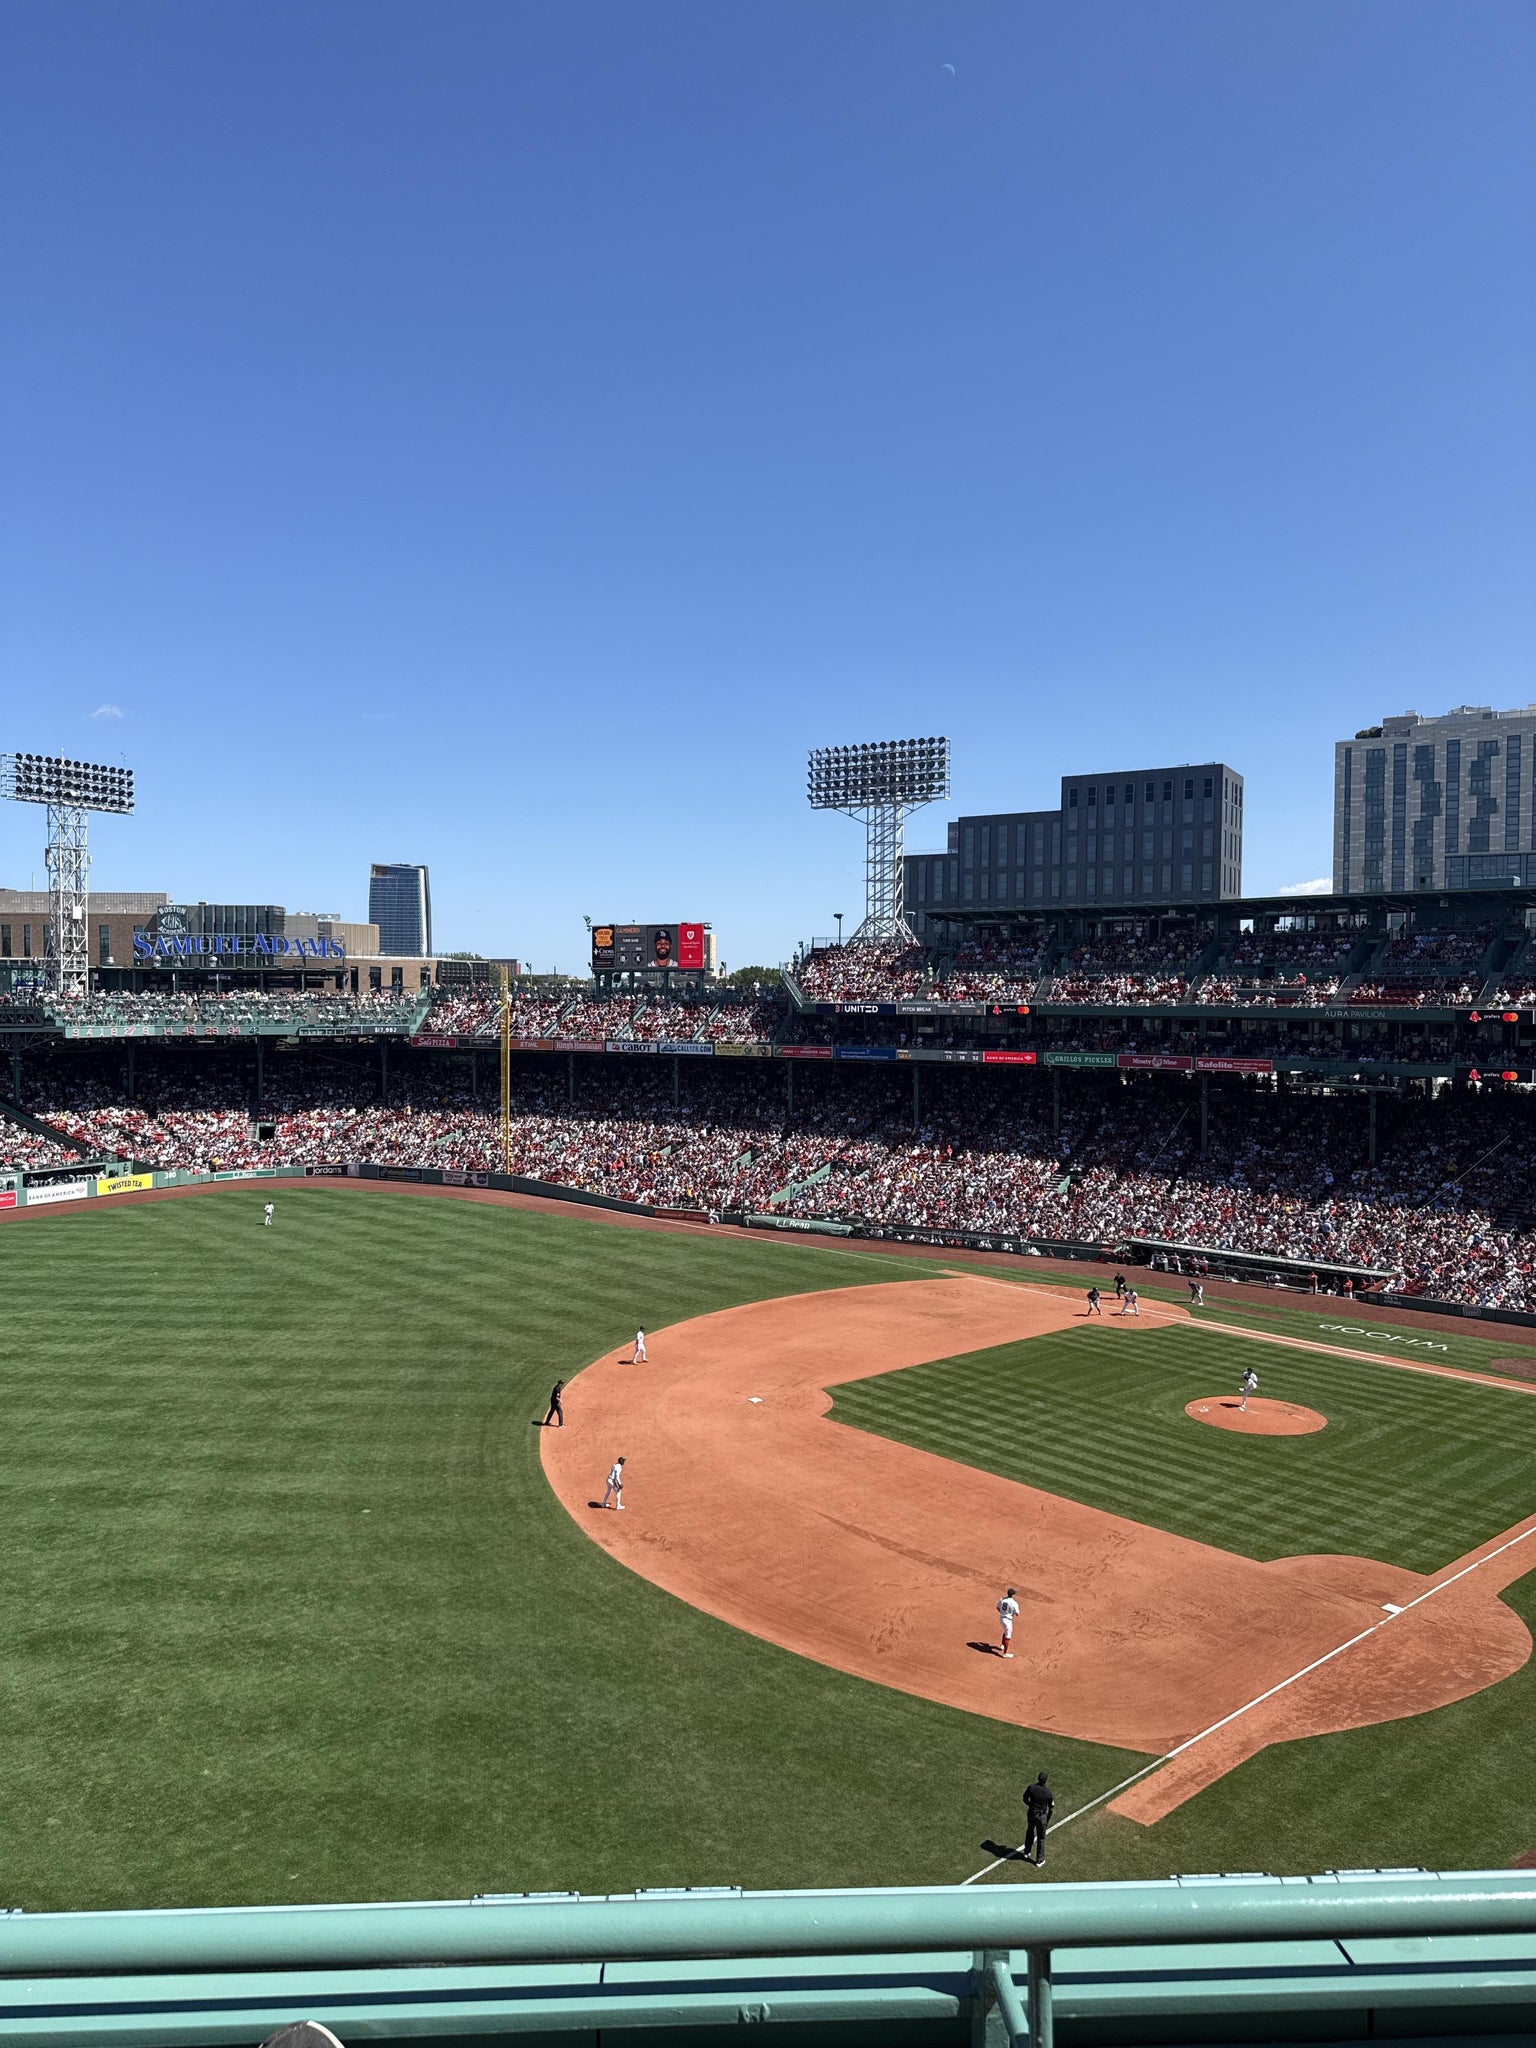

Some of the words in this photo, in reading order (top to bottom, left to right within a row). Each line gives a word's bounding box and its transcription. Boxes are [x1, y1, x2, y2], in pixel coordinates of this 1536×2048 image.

[158, 906, 187, 915] BOSTON
[158, 925, 187, 935] ACADEMY
[133, 932, 250, 960] SAMUEL
[251, 933, 345, 959] ADAMS
[844, 1005, 879, 1013] UNITED
[163, 1026, 174, 1036] 14
[182, 1026, 197, 1036] 45
[249, 1026, 261, 1036] 42
[574, 1042, 603, 1050] Hawaiian
[1132, 1058, 1152, 1066] Ninety
[1197, 1060, 1233, 1069] Safelite
[164, 1171, 177, 1180] 380
[107, 1180, 131, 1192] TWISTED
[132, 1180, 142, 1188] TEA
[29, 1193, 43, 1201] BANK
[52, 1190, 75, 1198] AMERICA
[1318, 1324, 1449, 1352] WHOOP
